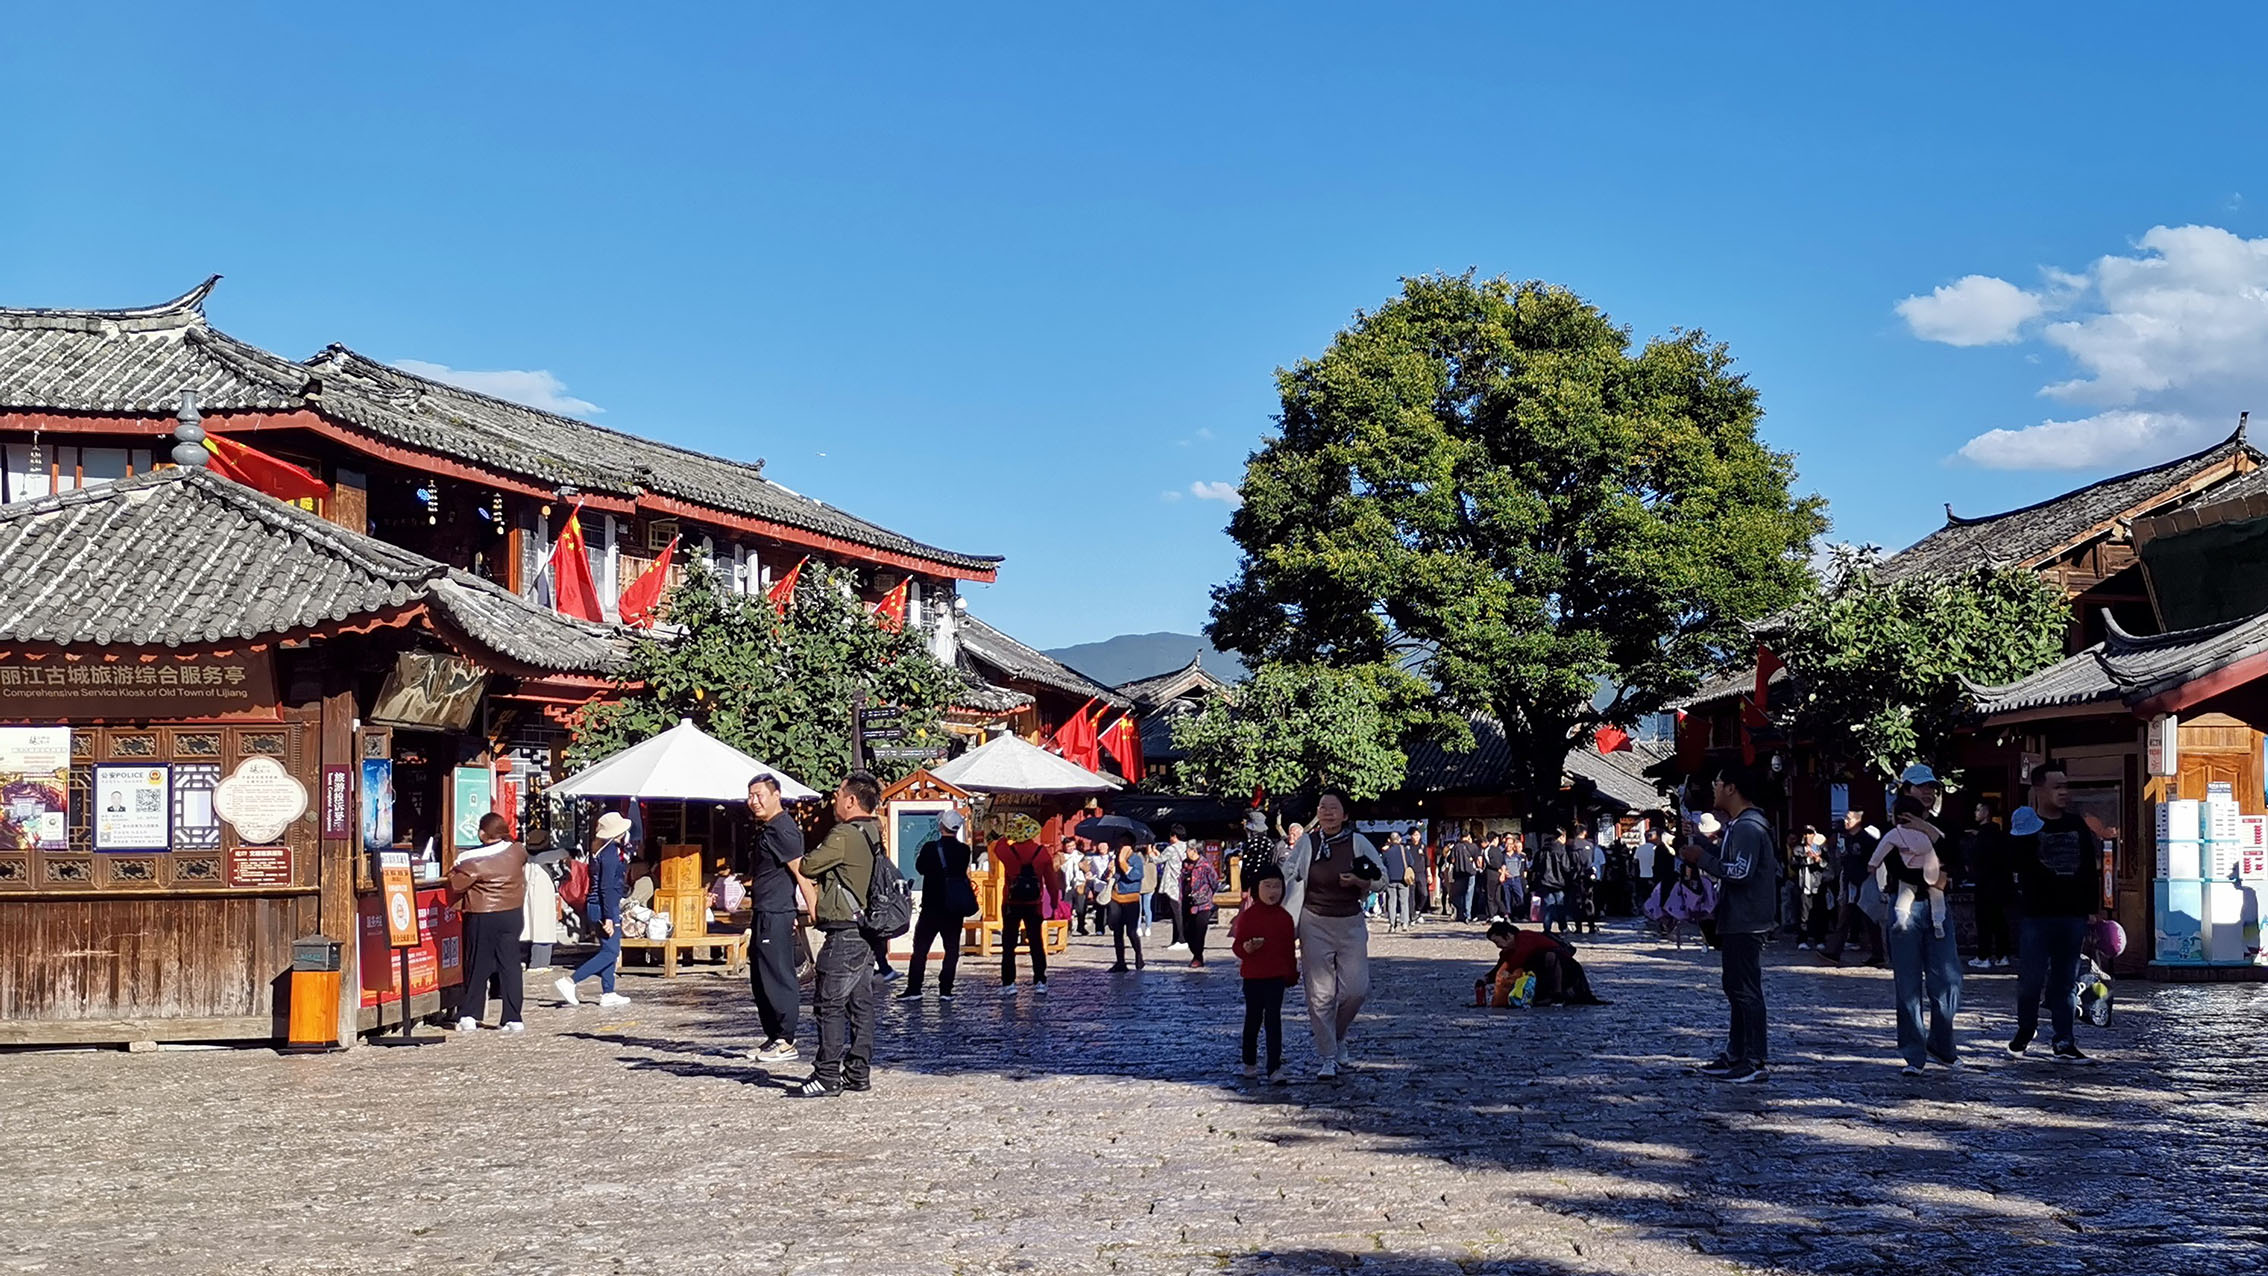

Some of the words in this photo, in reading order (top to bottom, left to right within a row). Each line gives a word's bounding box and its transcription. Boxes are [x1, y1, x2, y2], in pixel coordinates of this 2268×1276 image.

[0, 665, 245, 685] 丽江古城旅游综合服务亭
[3, 688, 79, 698] Comprehensive
[81, 688, 117, 697] Service
[119, 688, 145, 697] Kiosk
[147, 688, 157, 697] of
[159, 688, 176, 697] Old
[177, 688, 204, 697] Town
[205, 688, 214, 697] of
[216, 688, 248, 698] Lijiang
